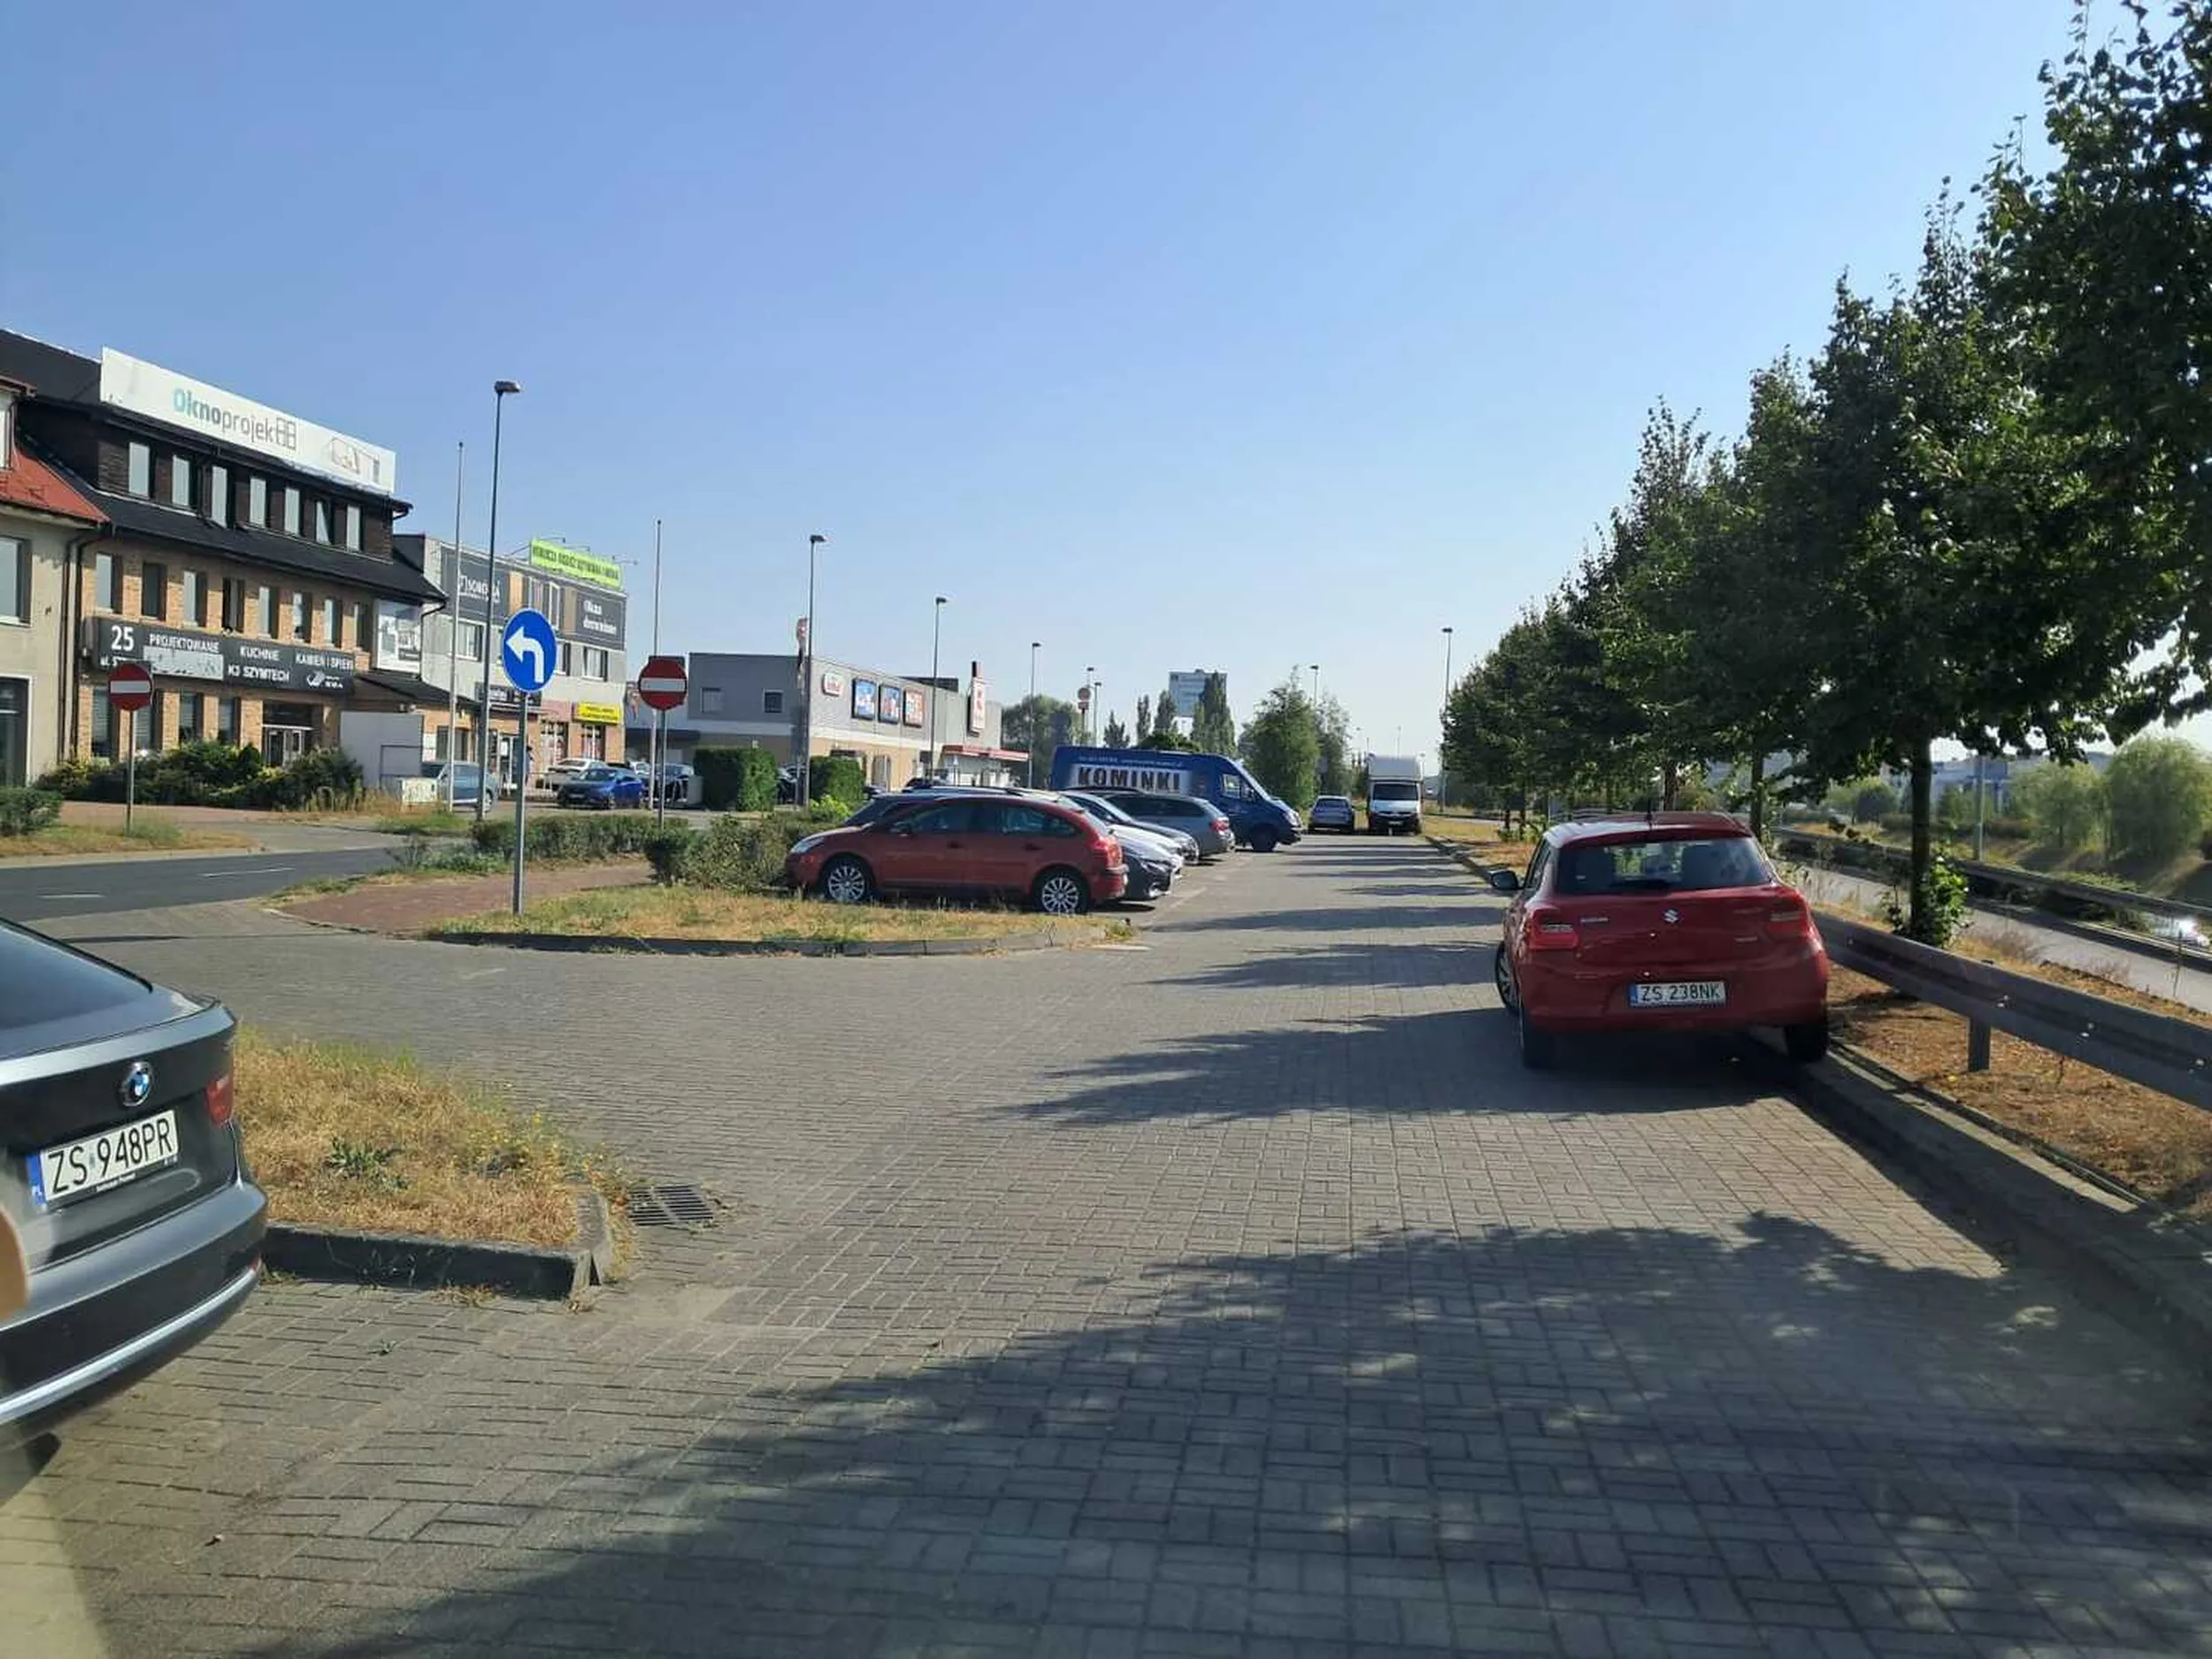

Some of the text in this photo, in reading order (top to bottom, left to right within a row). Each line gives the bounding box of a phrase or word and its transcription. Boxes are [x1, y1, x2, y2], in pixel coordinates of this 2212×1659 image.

[111, 625, 134, 652] 25
[149, 634, 220, 654] PROJEKTOWANIE
[240, 646, 280, 662] KUCHNIE
[1078, 766, 1180, 791] KOMINKI
[1640, 984, 1721, 1002] ZS 238NK
[48, 1118, 173, 1194] ZS 948PR
